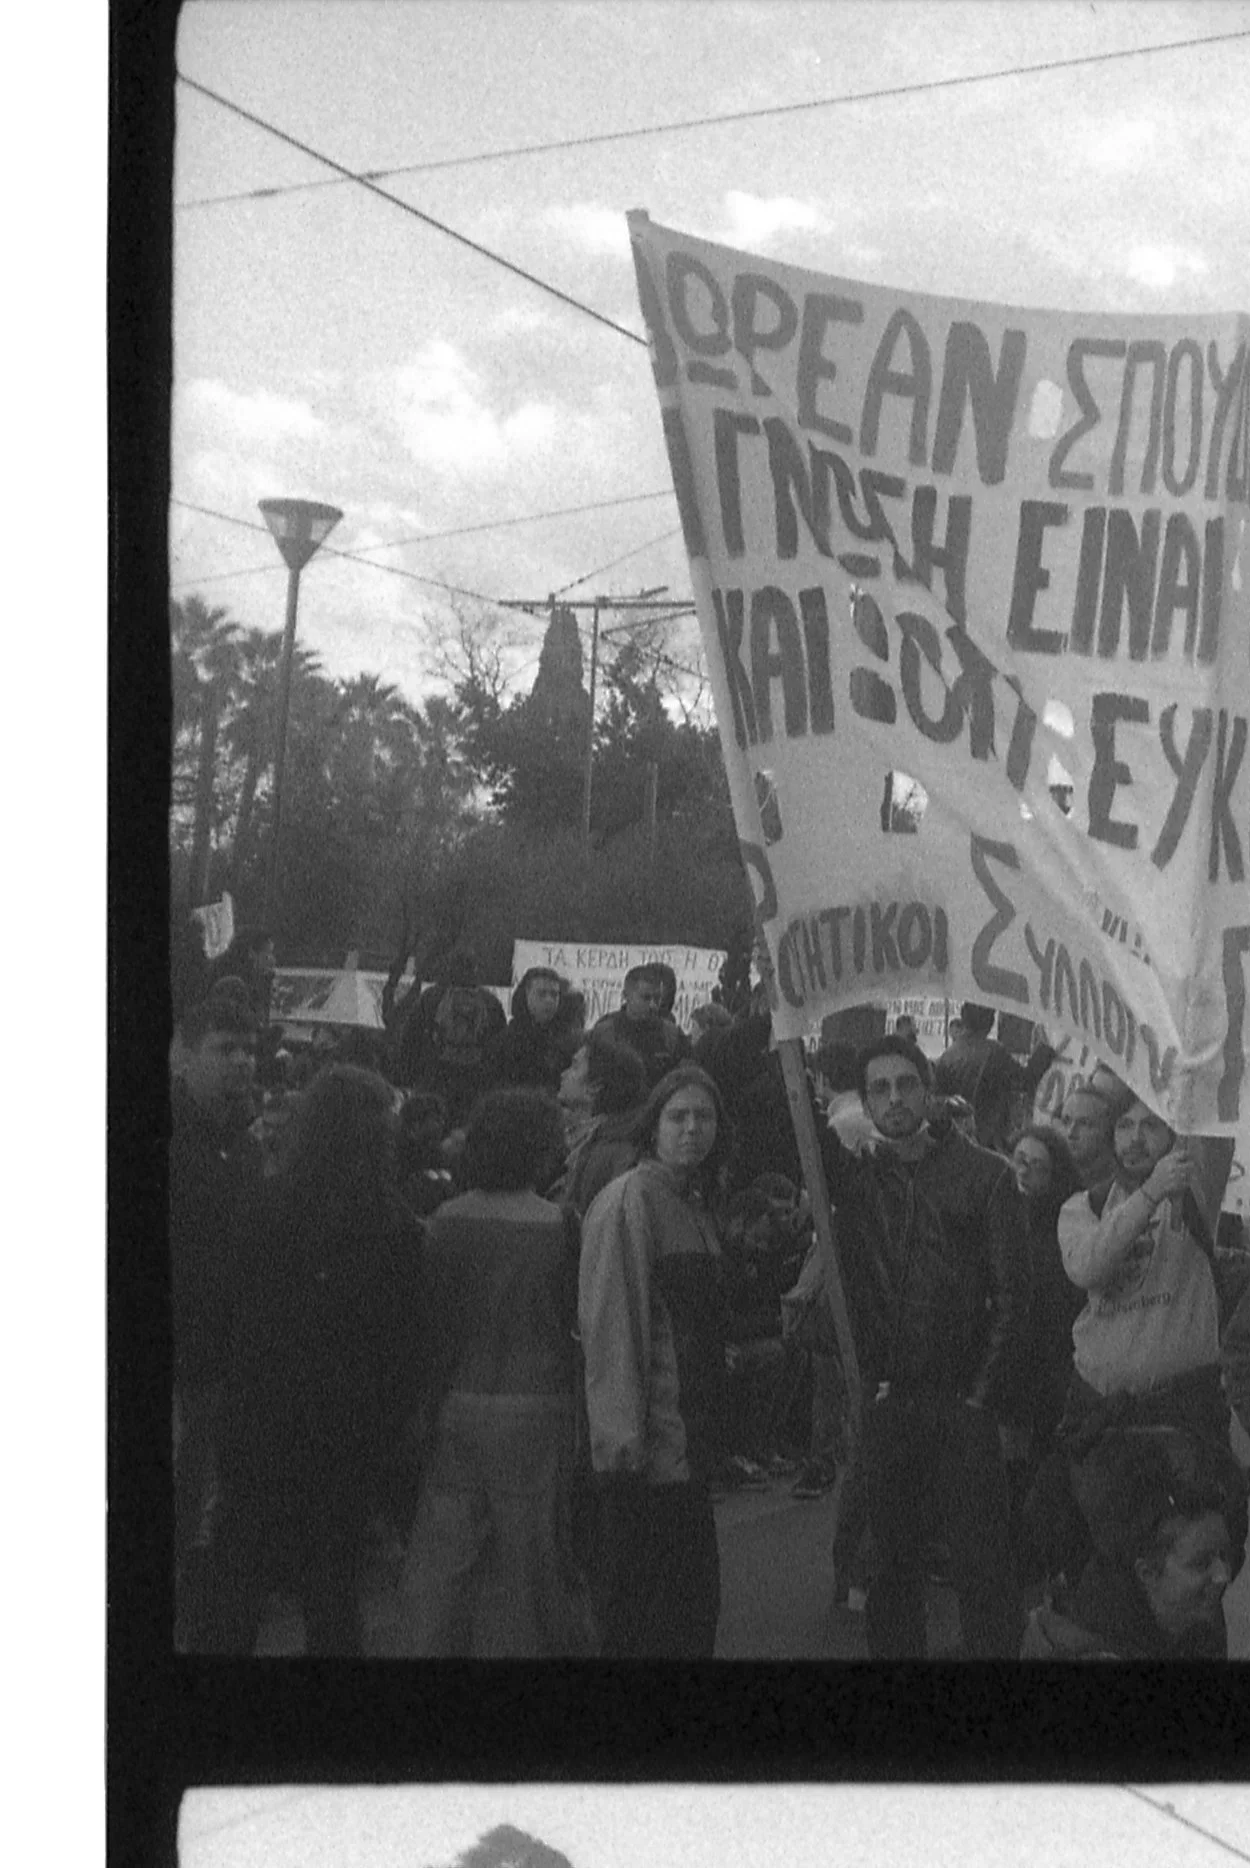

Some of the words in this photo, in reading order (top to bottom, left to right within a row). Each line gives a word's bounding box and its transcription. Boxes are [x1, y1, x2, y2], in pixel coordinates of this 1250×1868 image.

[1007, 499, 1224, 666] ΕΙΝΑΙ
[711, 586, 835, 751] ΚΑΙ
[577, 948, 629, 969] ΚΕΡΔΗ
